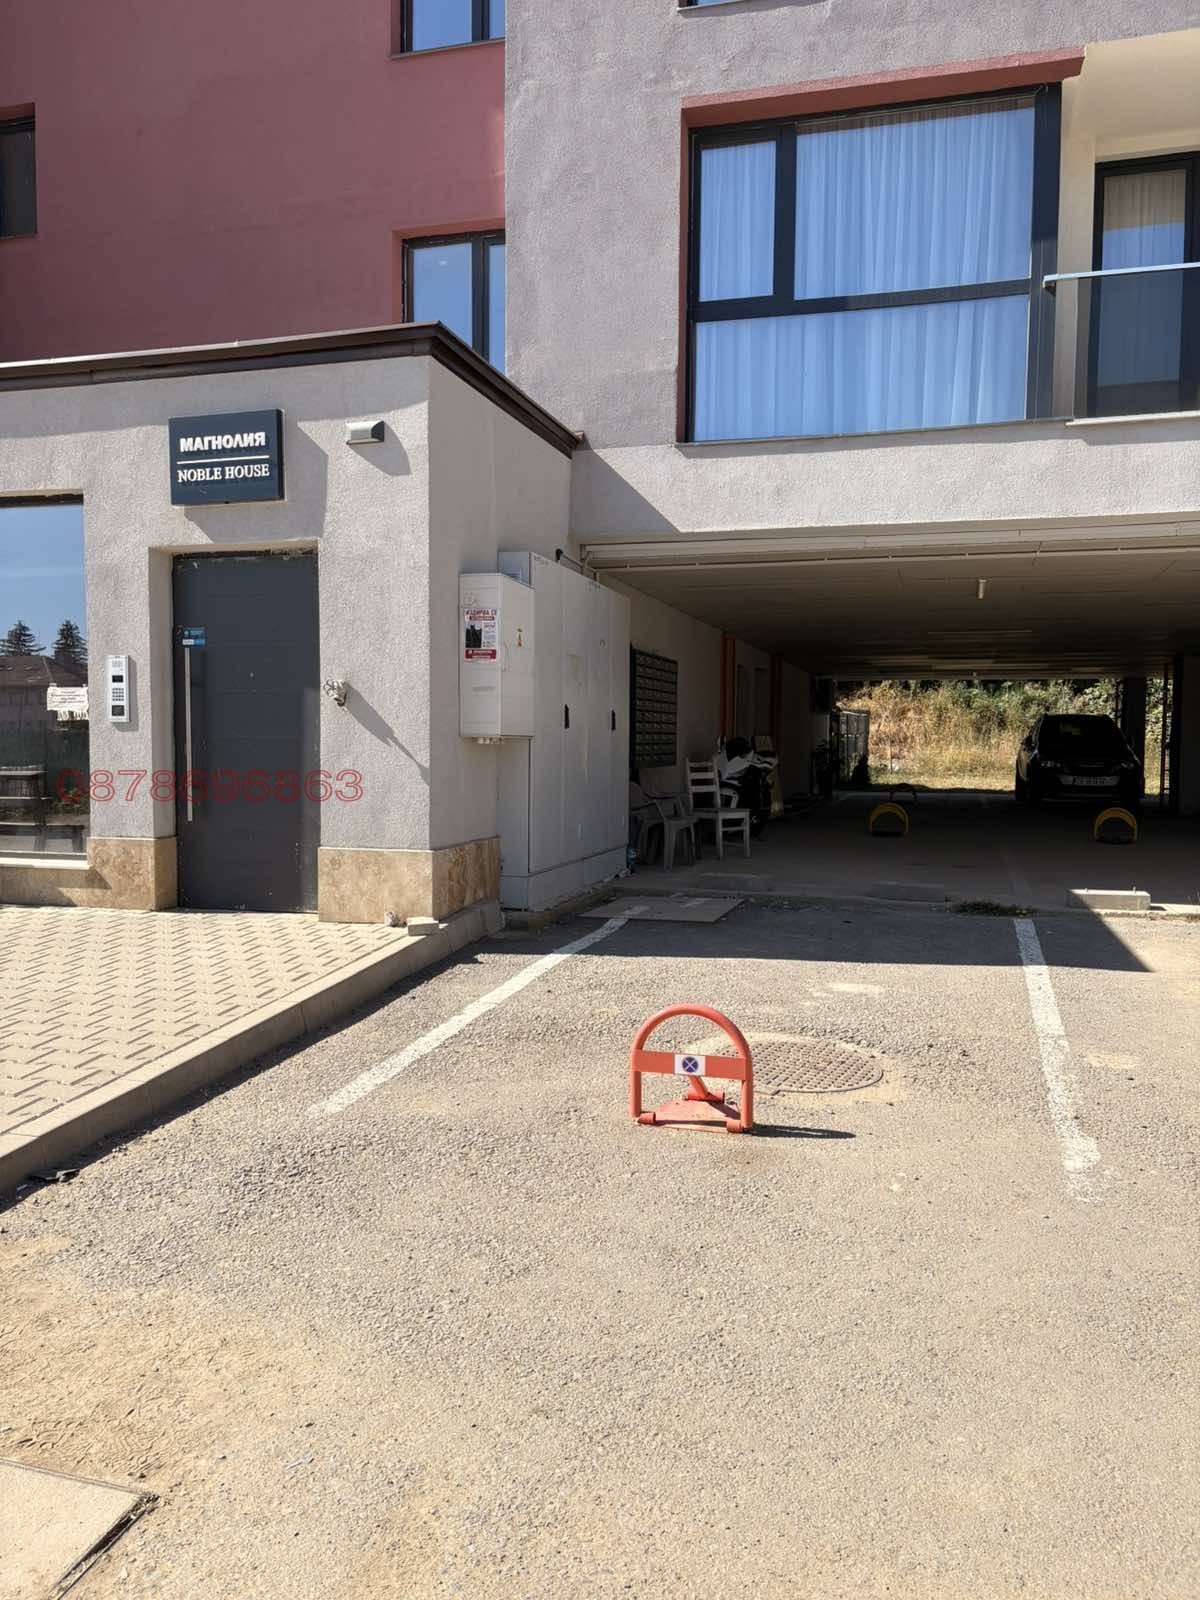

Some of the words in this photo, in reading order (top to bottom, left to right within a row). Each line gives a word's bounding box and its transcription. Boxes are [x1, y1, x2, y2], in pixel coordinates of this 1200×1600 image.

[179, 432, 266, 453] МАГНОЛИЯ
[177, 466, 222, 483] NOBLE
[225, 463, 270, 479] HOUSE
